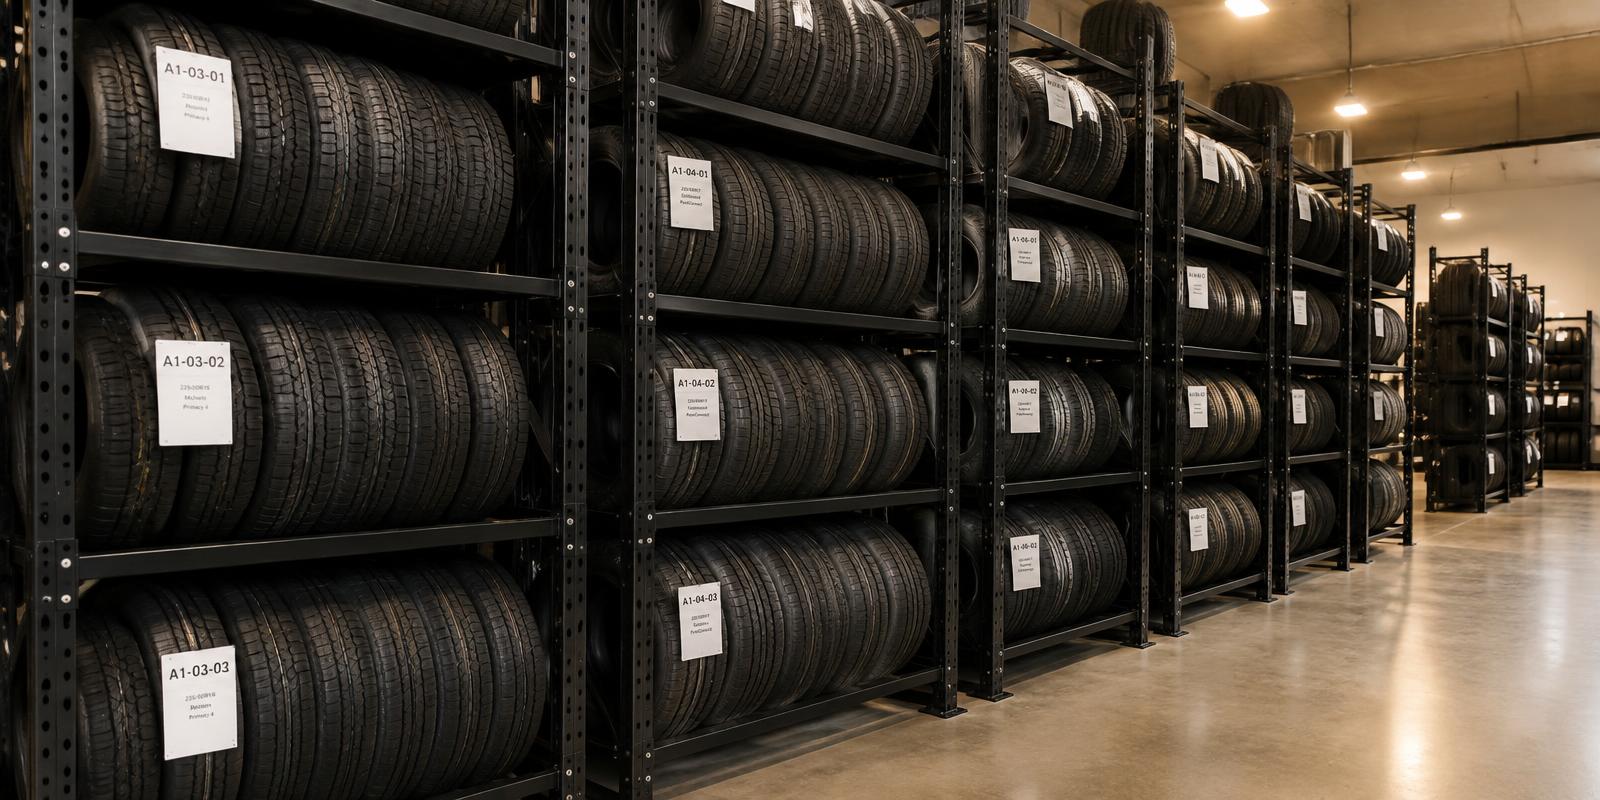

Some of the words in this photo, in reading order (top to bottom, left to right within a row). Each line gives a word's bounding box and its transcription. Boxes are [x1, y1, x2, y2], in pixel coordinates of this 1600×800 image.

[164, 62, 225, 84] A1-03-01
[671, 166, 708, 178] A1-04-01
[163, 355, 225, 368] A1-03-02
[678, 379, 715, 388] A1-04-02
[682, 592, 718, 606] A1-04-03
[169, 661, 230, 680] A1-03-03
